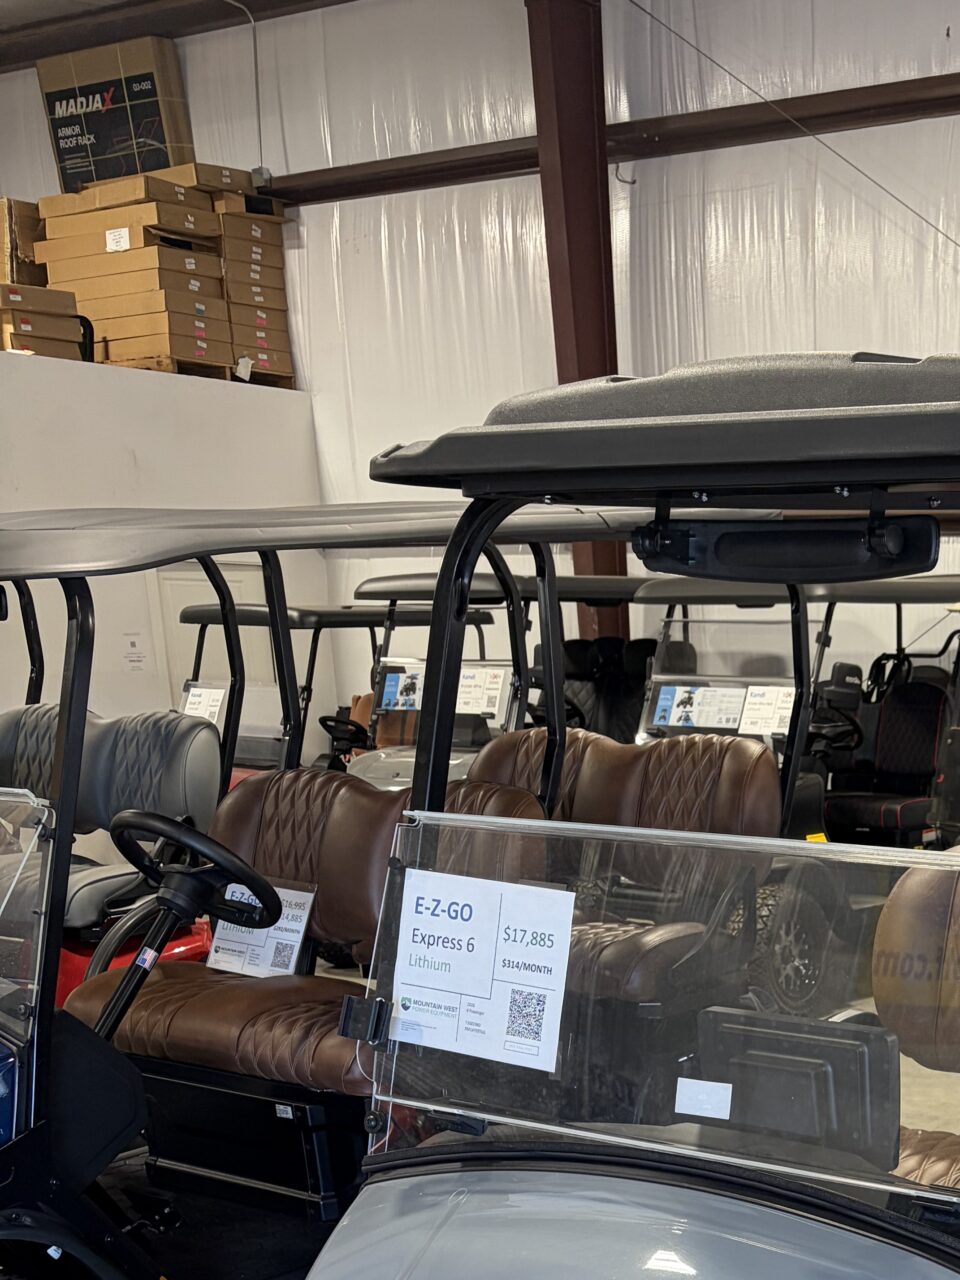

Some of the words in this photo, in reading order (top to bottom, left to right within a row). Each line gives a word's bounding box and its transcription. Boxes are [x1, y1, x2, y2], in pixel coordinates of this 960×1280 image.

[132, 81, 152, 92] 03-002
[54, 87, 116, 118] MADJAX
[58, 125, 81, 137] ARMOR
[59, 138, 78, 149] ROOF
[78, 134, 97, 146] RACK
[414, 896, 473, 922] E-Z-GO
[411, 928, 463, 951] Express
[466, 937, 475, 953] 6
[503, 925, 555, 949] $17,885
[408, 953, 451, 973] Lithium
[501, 958, 553, 976] $314/MONTH
[412, 998, 443, 1010] MOUNTAIN
[443, 1005, 459, 1013] WEST
